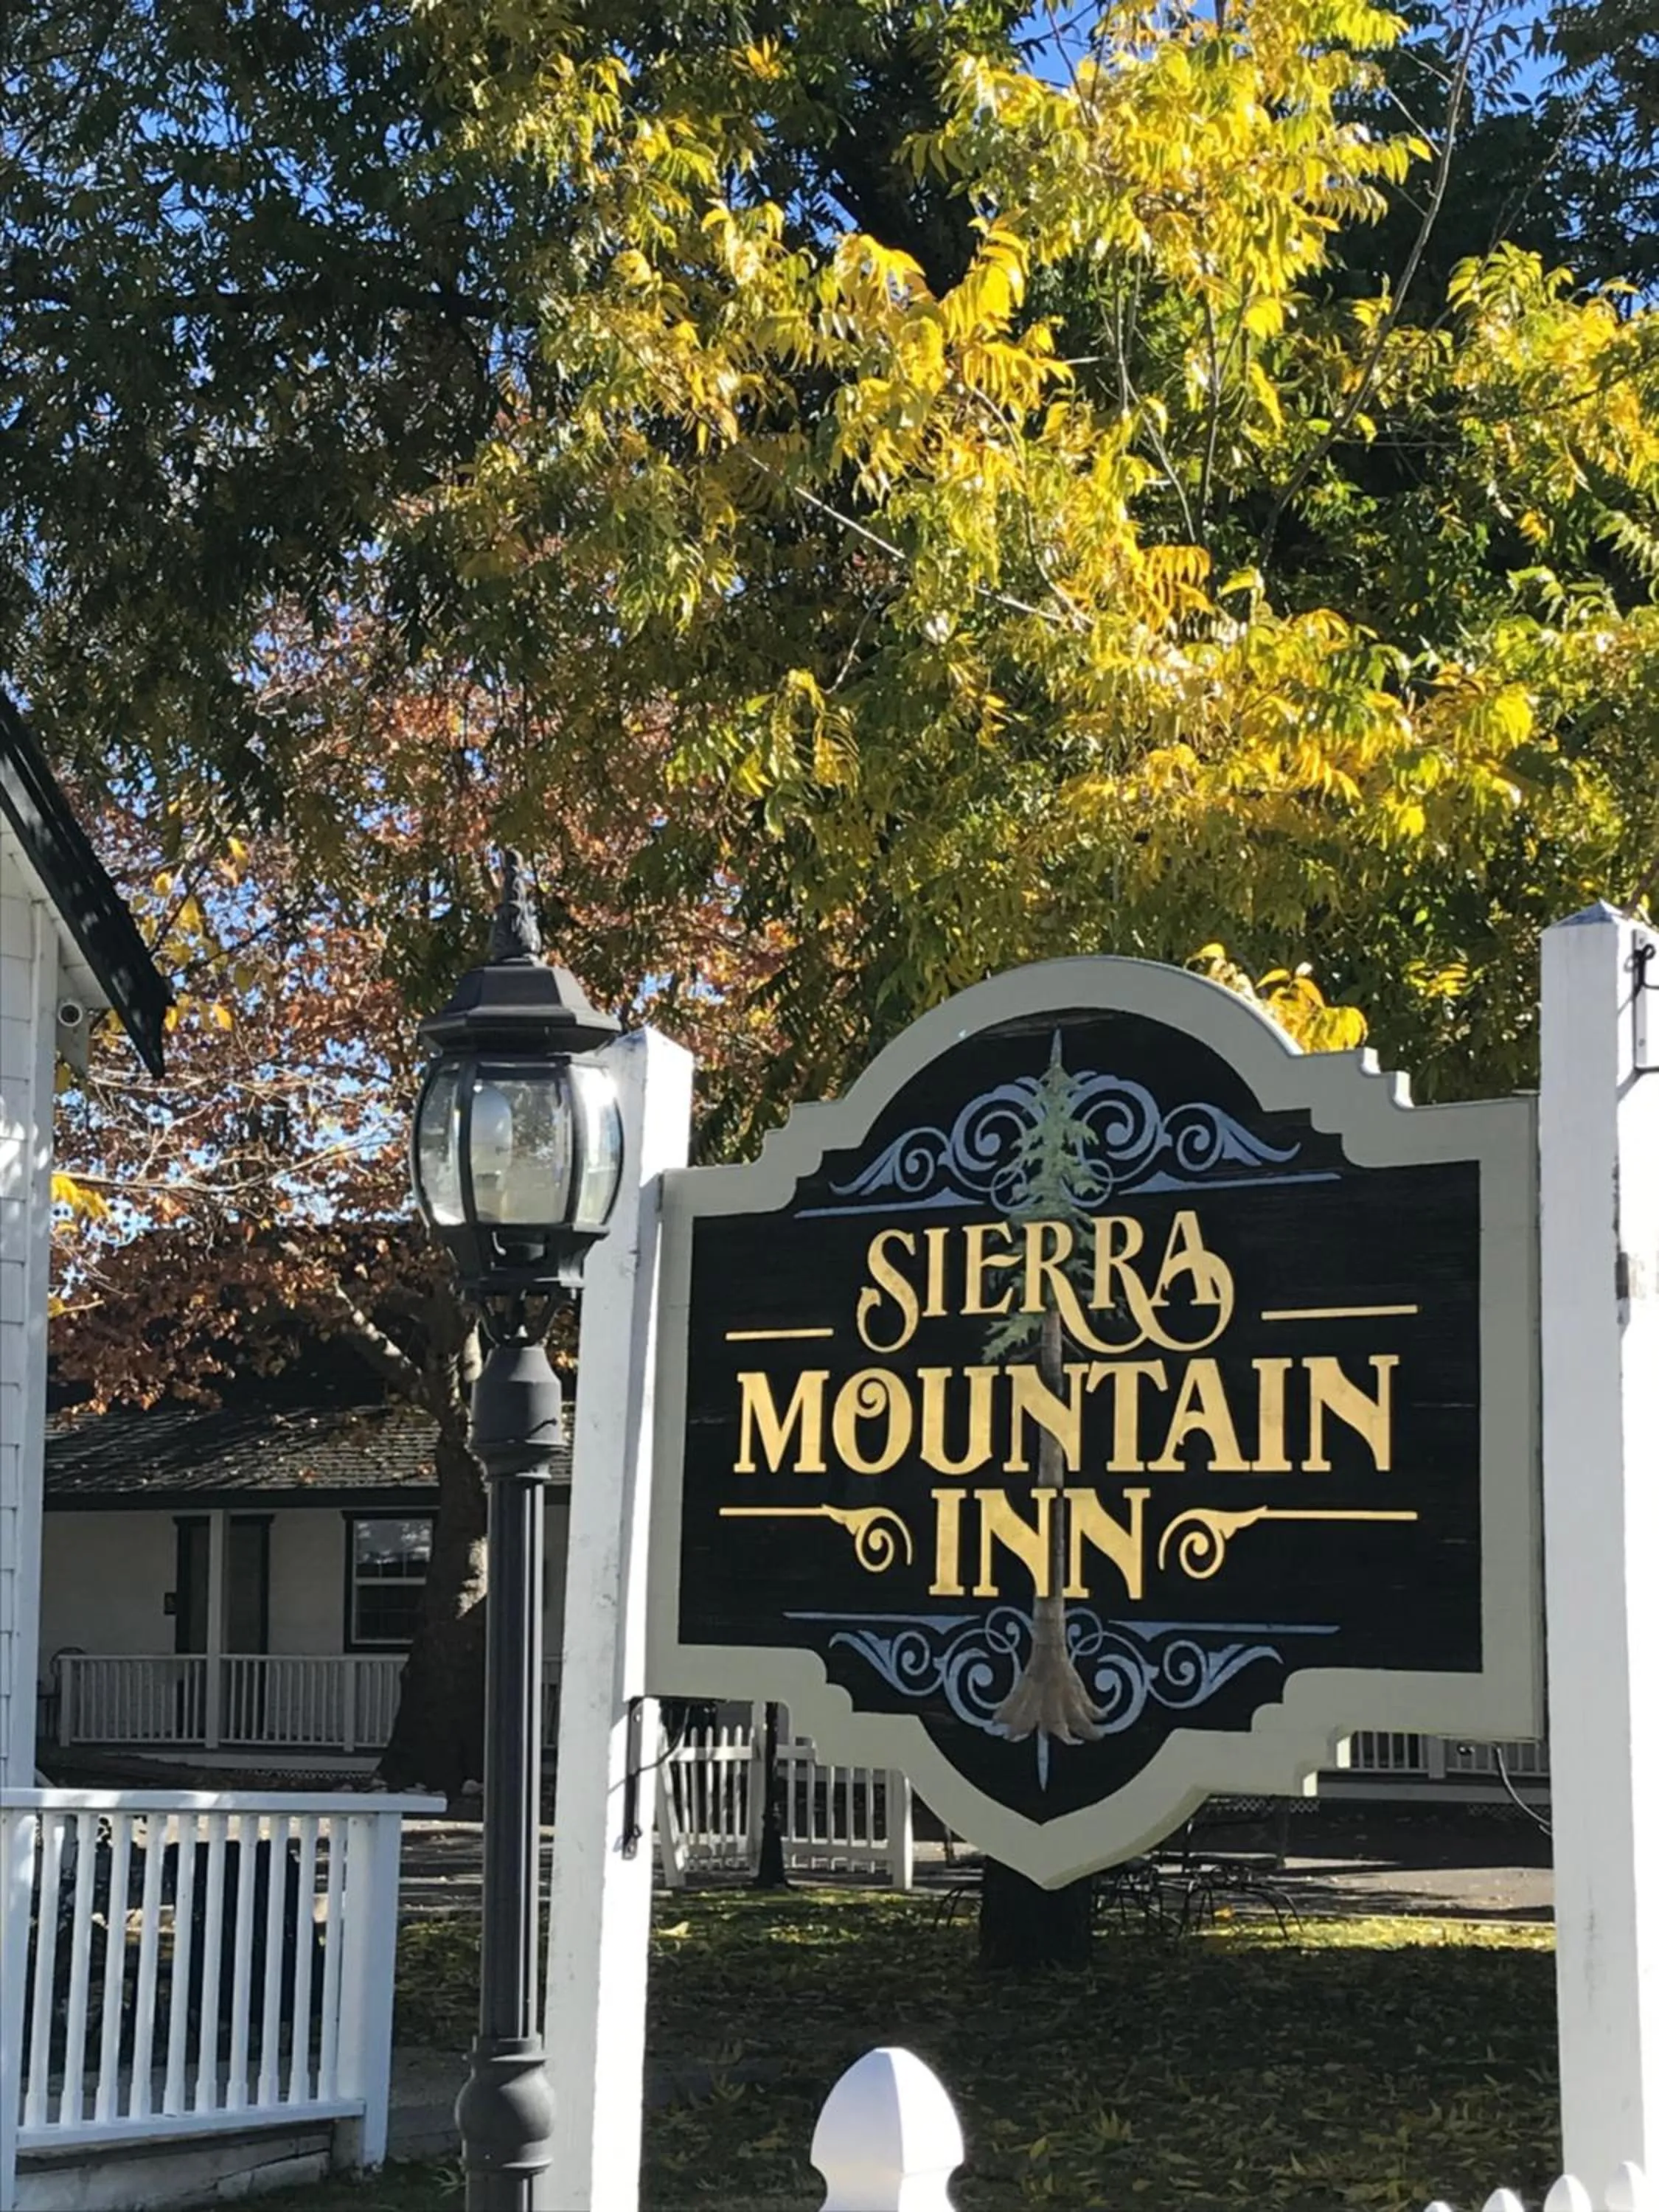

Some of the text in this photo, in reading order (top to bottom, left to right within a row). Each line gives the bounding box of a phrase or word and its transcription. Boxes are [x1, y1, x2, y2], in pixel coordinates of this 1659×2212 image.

[857, 1210, 1234, 1354] SIERRA
[734, 1355, 1399, 1475] MOUNTAIN
[928, 1487, 1150, 1600] INN
